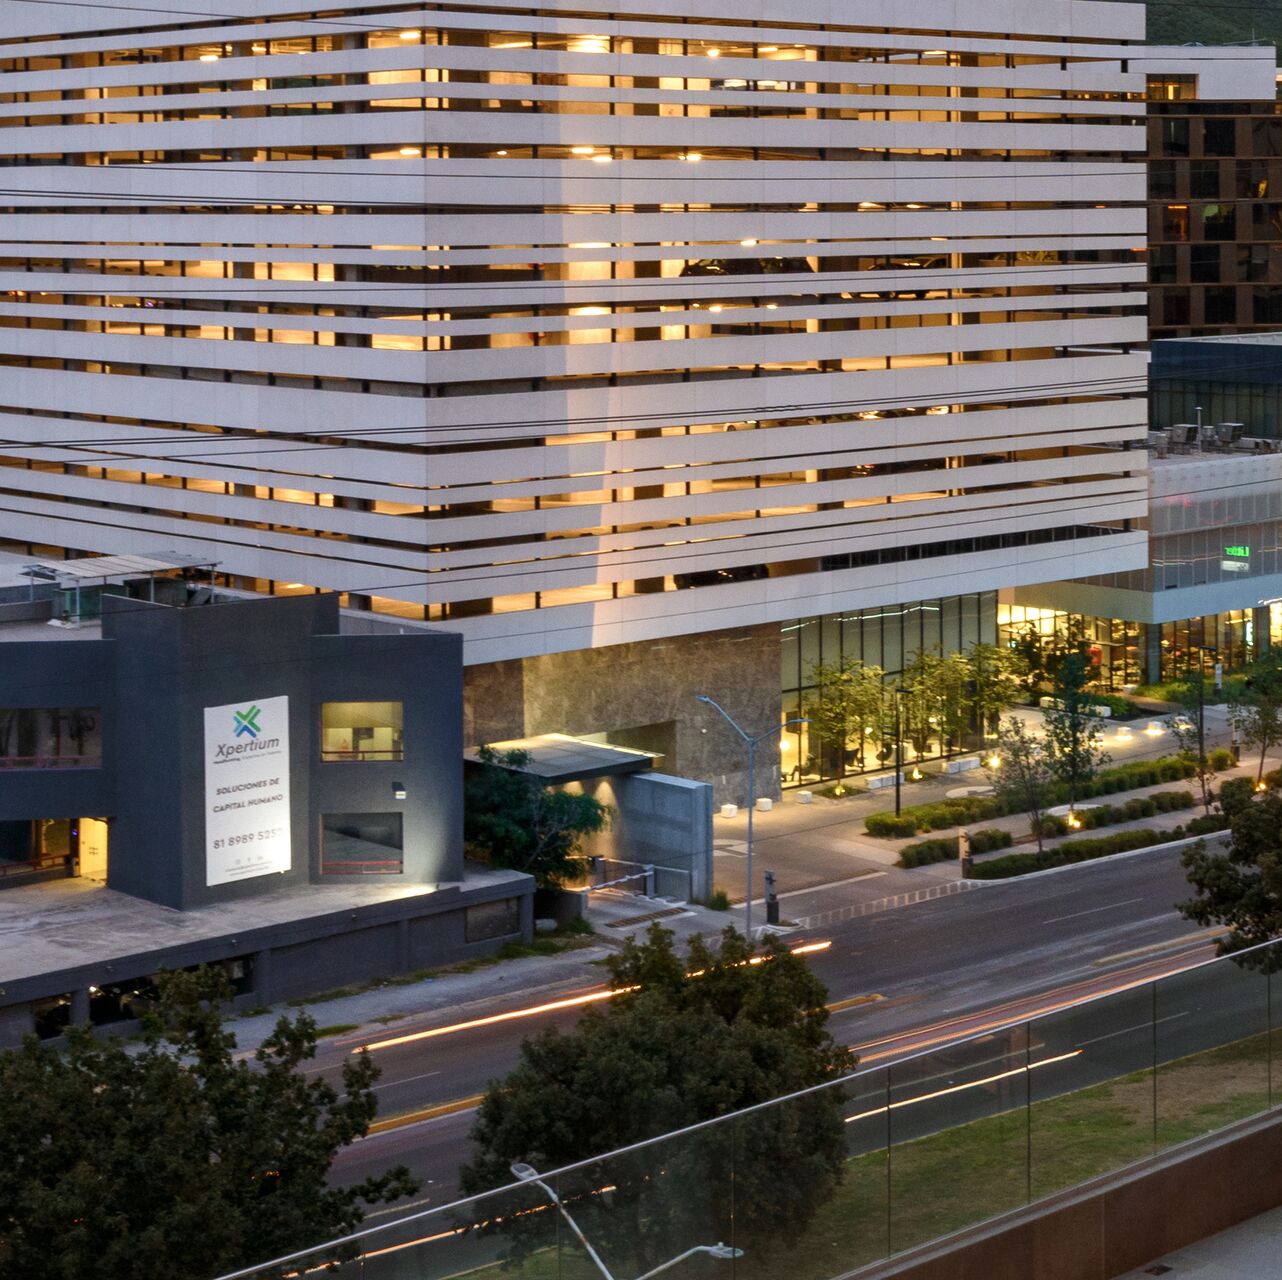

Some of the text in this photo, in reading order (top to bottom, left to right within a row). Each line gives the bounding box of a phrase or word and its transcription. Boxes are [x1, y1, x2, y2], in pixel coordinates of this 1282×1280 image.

[215, 738, 280, 758] Xpertium
[216, 777, 280, 795] SOLUCIONES DE
[213, 794, 284, 813] CAPITAL HUMANO
[213, 839, 225, 849] 81
[228, 833, 255, 847] 8989
